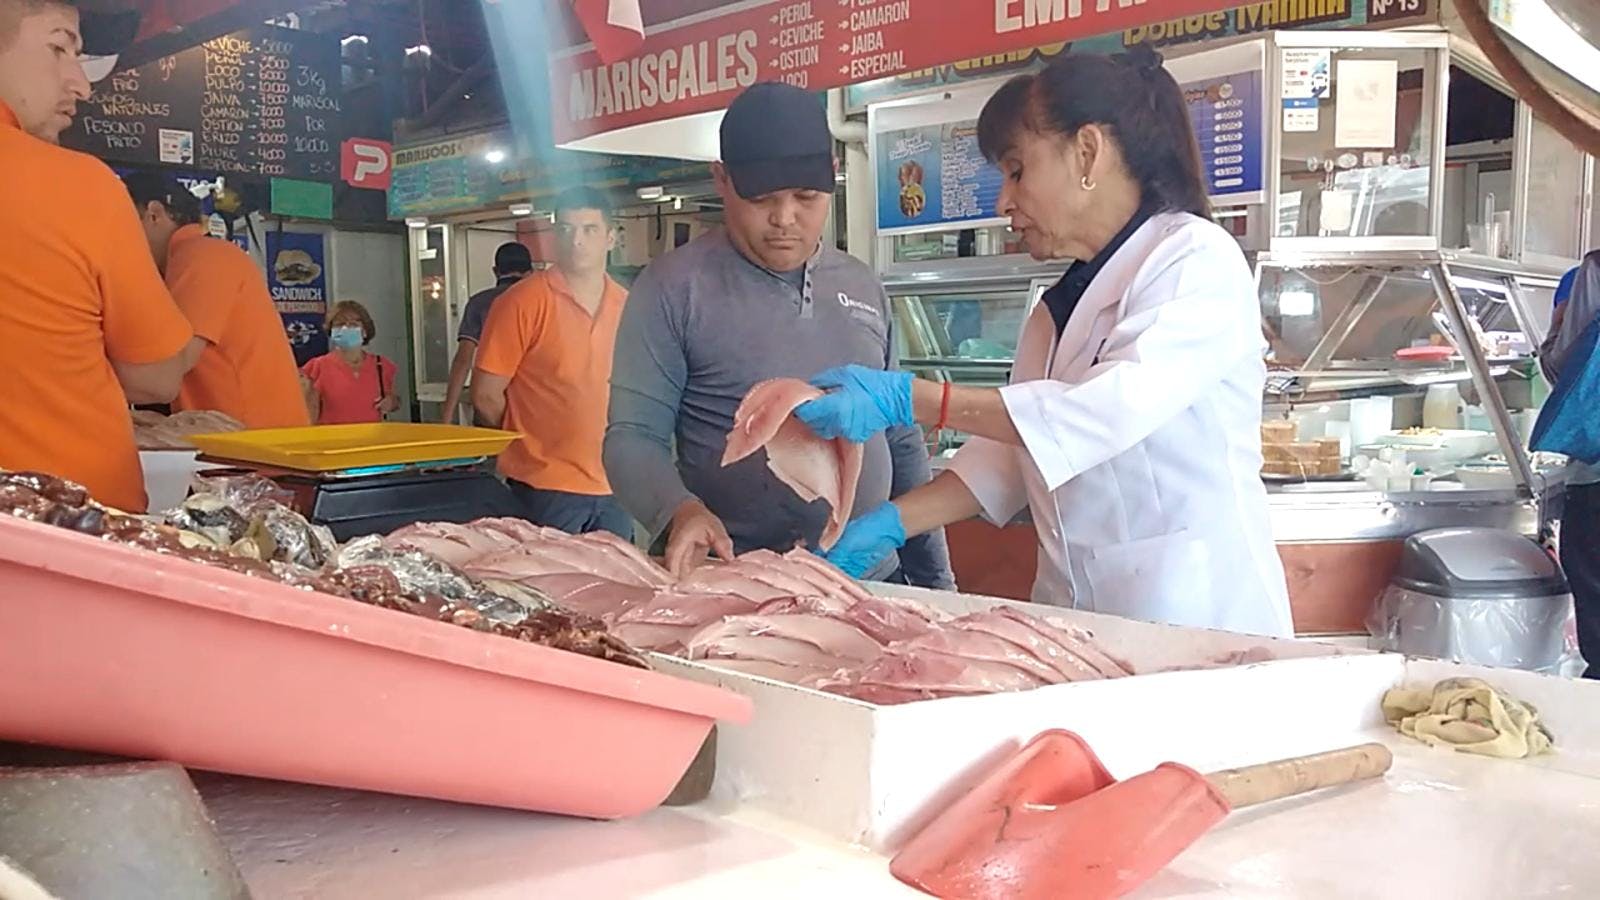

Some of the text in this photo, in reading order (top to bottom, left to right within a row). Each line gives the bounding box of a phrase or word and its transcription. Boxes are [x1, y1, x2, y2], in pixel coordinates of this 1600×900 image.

[780, 1, 815, 26] PEROL
[850, 0, 910, 31] CAMARON
[779, 20, 825, 48] CEVICHE
[850, 31, 885, 56] JAIBA
[779, 45, 819, 70] OSTION
[851, 50, 908, 79] ESPECIAL
[205, 75, 245, 92] PULPO
[206, 64, 241, 78] LOCO
[569, 30, 759, 121] MARISCALES
[83, 116, 146, 136] PESCADO
[202, 130, 240, 145] ERIZO
[271, 286, 323, 301] SANDWICH
